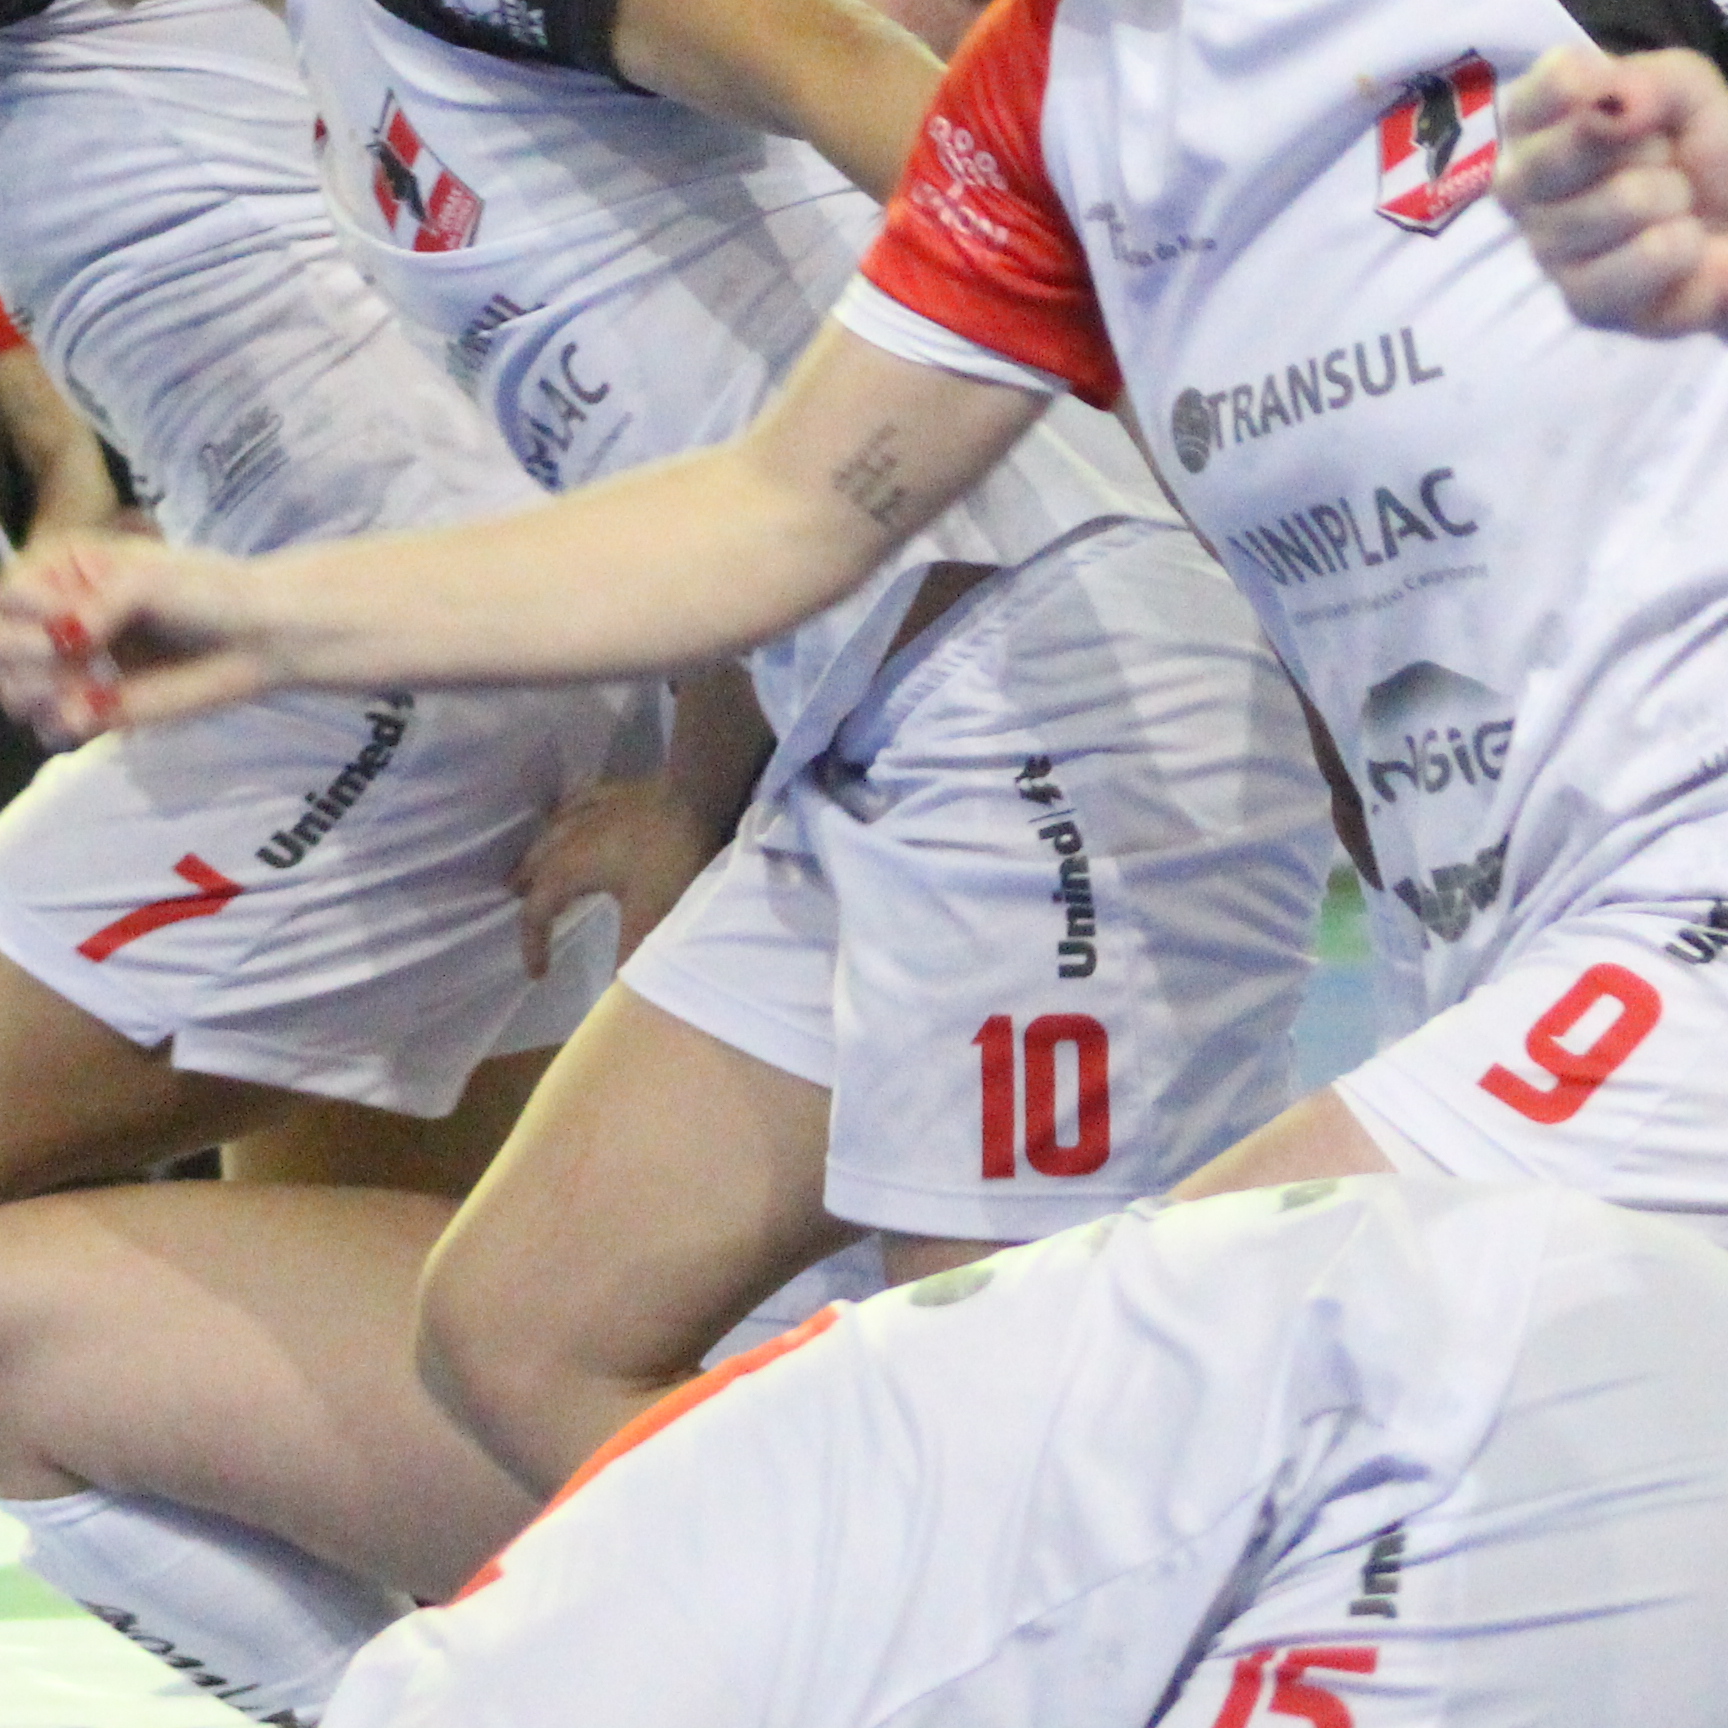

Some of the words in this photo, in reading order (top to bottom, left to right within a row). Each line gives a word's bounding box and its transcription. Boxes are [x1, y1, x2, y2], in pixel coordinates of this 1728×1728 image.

[1208, 327, 1445, 451] TRANSUL
[254, 710, 408, 870] Unimed
[76, 851, 247, 964] 7
[970, 1011, 1112, 1181] 10
[1475, 962, 1665, 1125] 9
